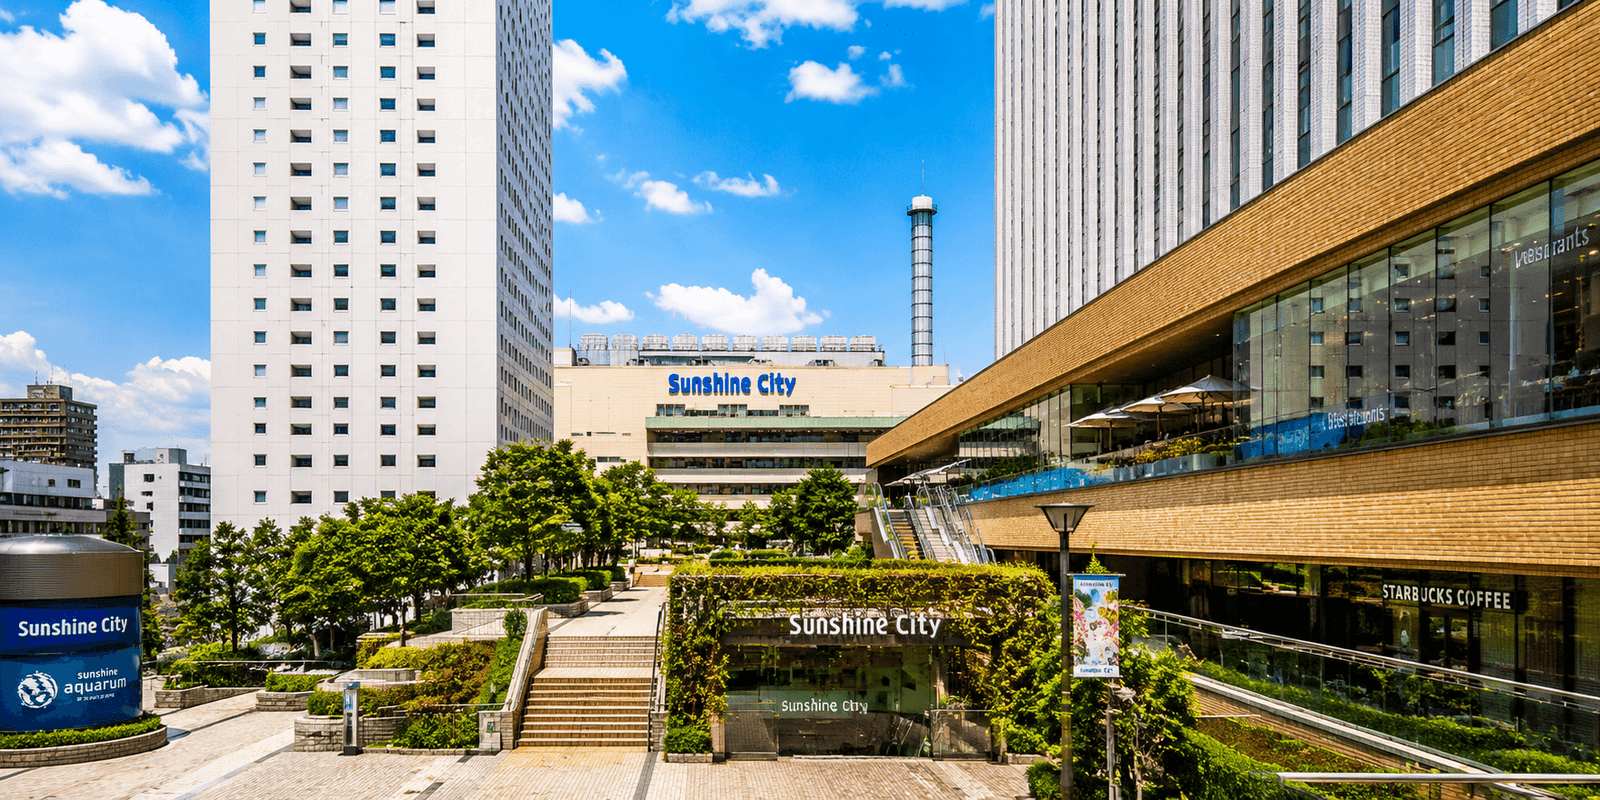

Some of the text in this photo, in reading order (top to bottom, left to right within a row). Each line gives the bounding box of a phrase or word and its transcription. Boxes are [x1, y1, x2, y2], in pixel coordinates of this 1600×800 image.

[668, 372, 797, 398] Sunshine City
[1382, 584, 1511, 609] STARBUCKS COFFEE
[18, 616, 128, 637] Sunshine City
[789, 612, 941, 638] Sunshine City
[77, 667, 118, 680] sunshine
[781, 698, 838, 712] Sunshine
